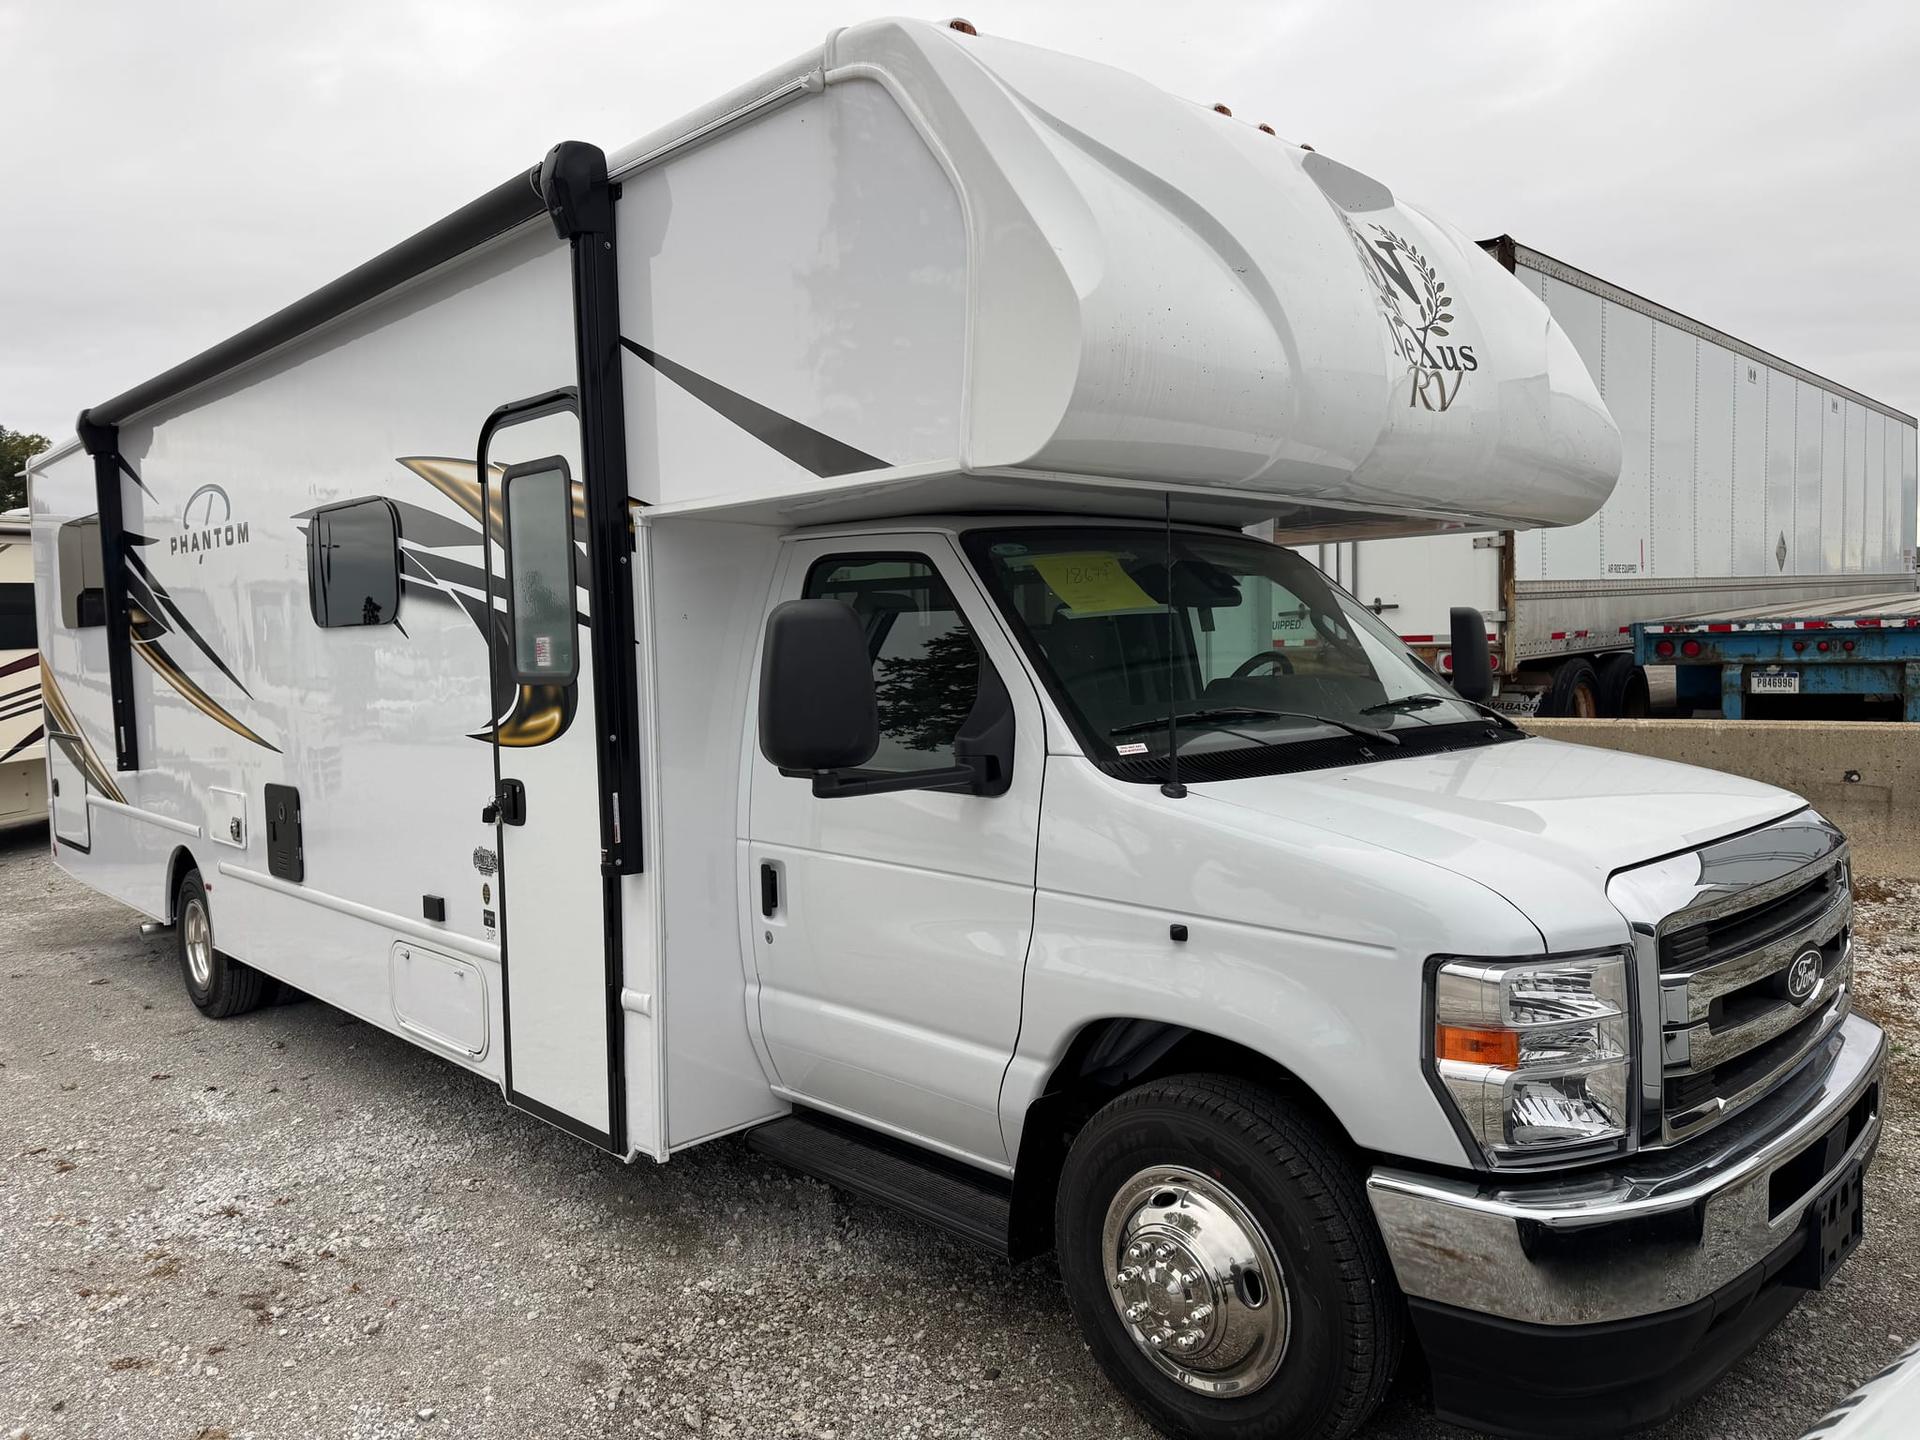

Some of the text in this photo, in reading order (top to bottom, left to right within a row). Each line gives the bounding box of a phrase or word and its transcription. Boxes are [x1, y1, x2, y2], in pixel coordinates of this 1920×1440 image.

[1407, 365, 1464, 412] RV
[170, 521, 249, 556] PHANTOM
[1796, 957, 1817, 992] Ford
